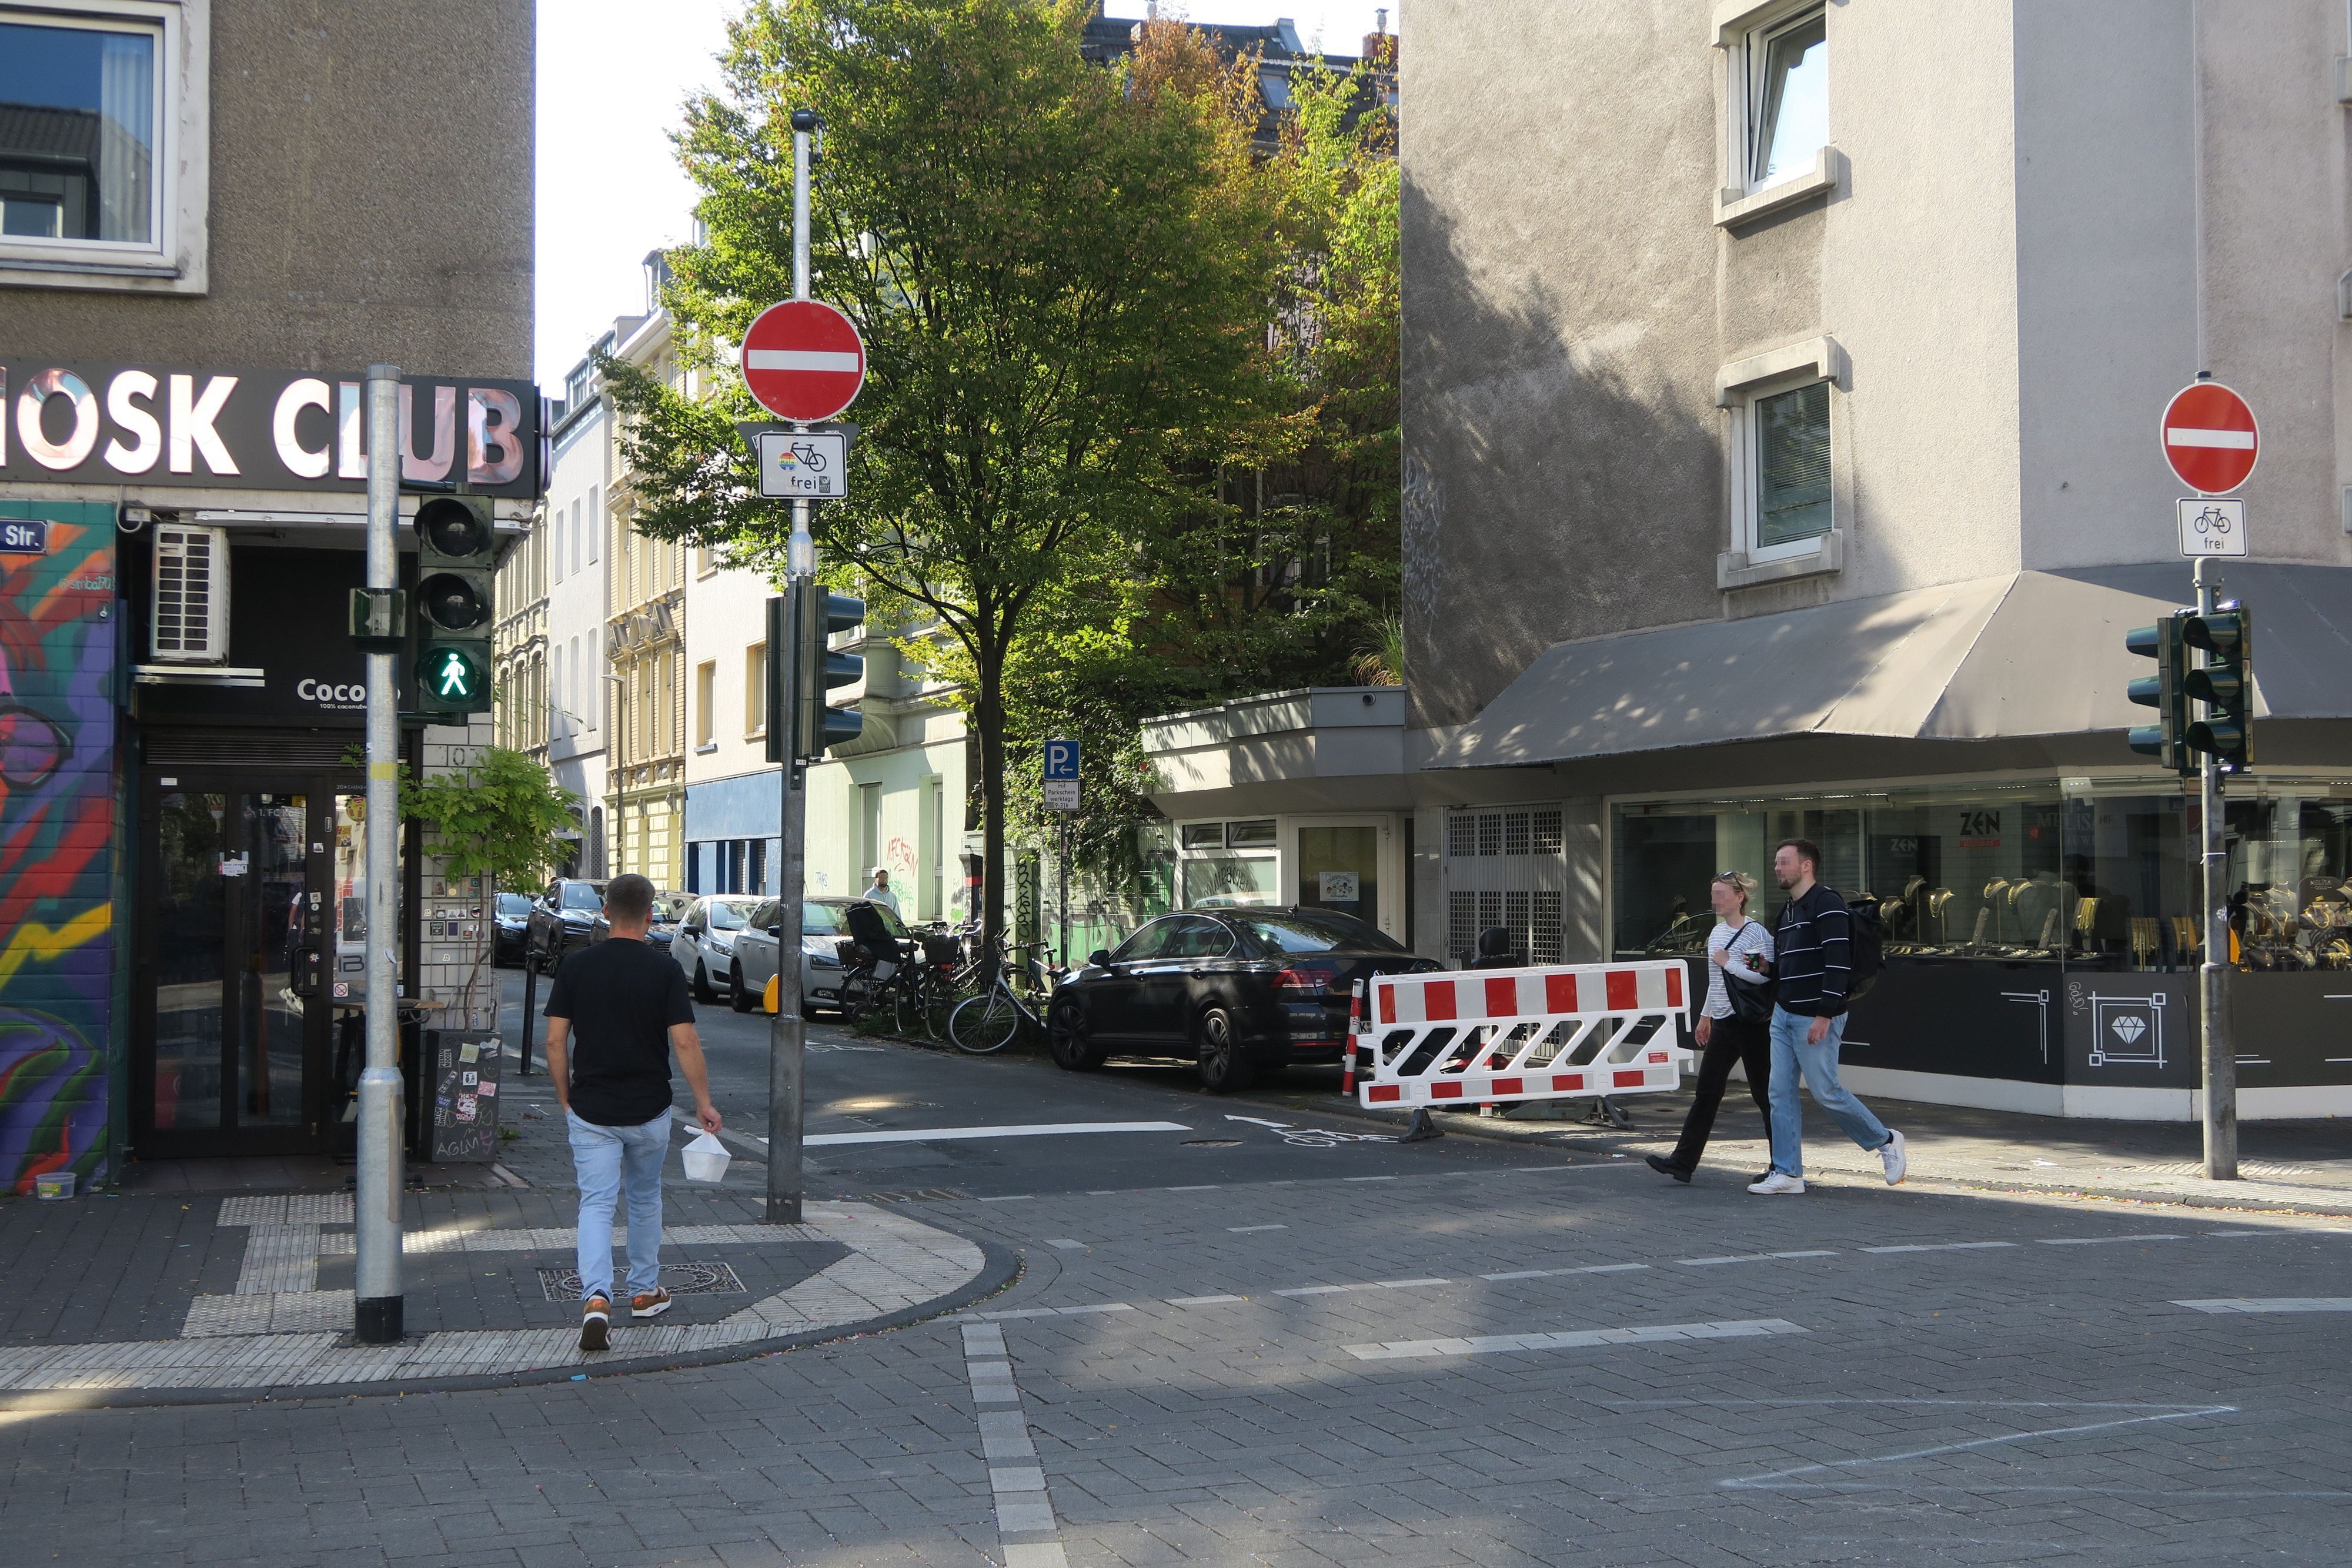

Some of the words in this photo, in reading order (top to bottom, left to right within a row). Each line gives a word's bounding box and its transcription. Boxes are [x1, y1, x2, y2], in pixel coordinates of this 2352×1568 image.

[0, 367, 240, 476] OSK
[273, 378, 523, 486] CLUB
[790, 476, 816, 489] frei
[5, 524, 39, 546] Str.
[2204, 536, 2224, 550] frei
[1050, 745, 1068, 774] P
[1959, 811, 2000, 836] ZEN
